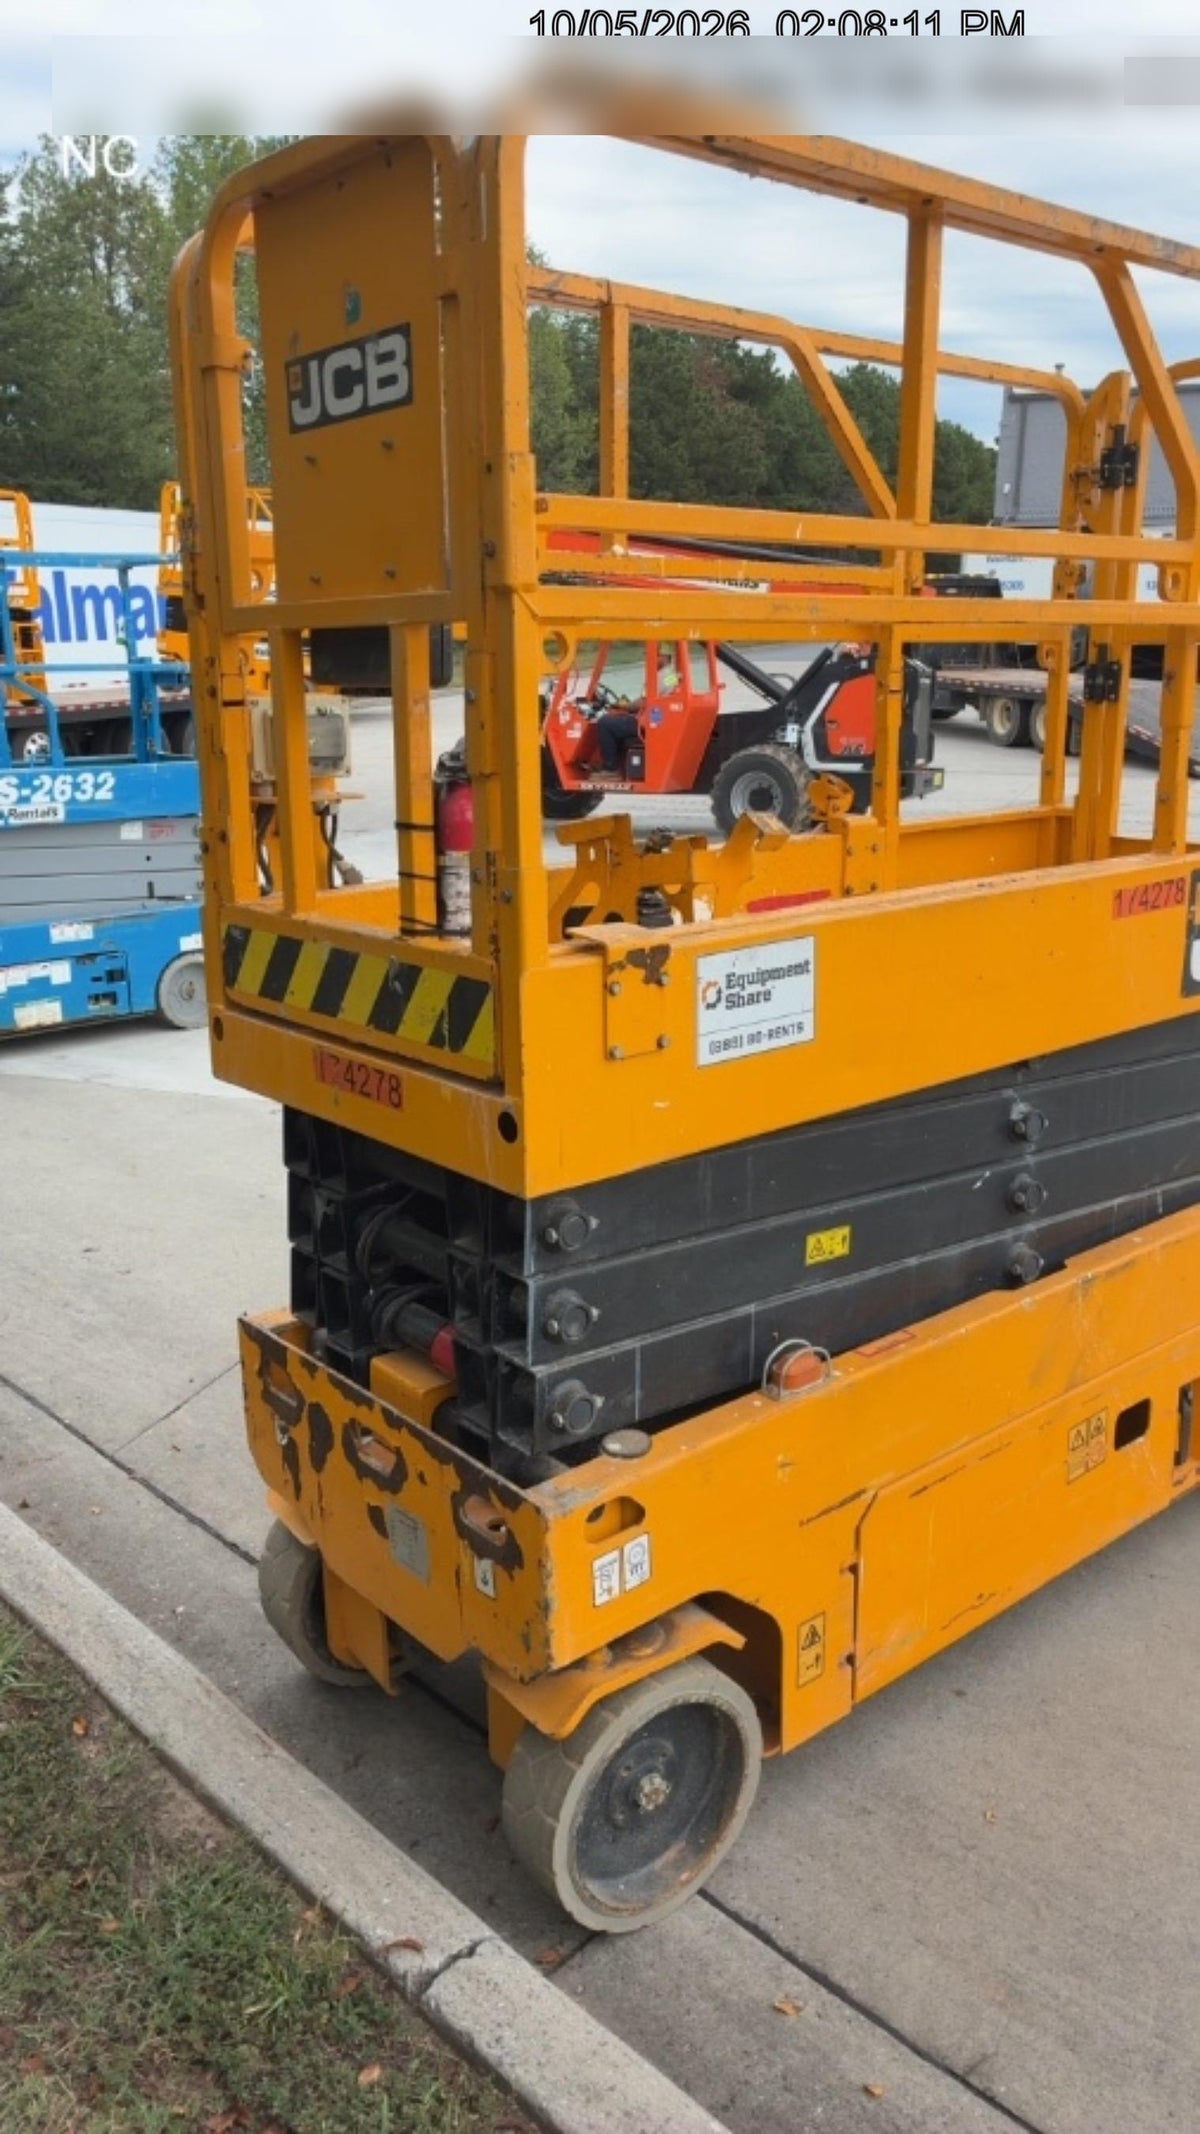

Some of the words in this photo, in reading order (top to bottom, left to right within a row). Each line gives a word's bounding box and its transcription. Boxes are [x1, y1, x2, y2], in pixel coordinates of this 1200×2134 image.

[290, 332, 410, 426] JCB
[724, 959, 811, 991] Equipment
[724, 987, 772, 1011] Share
